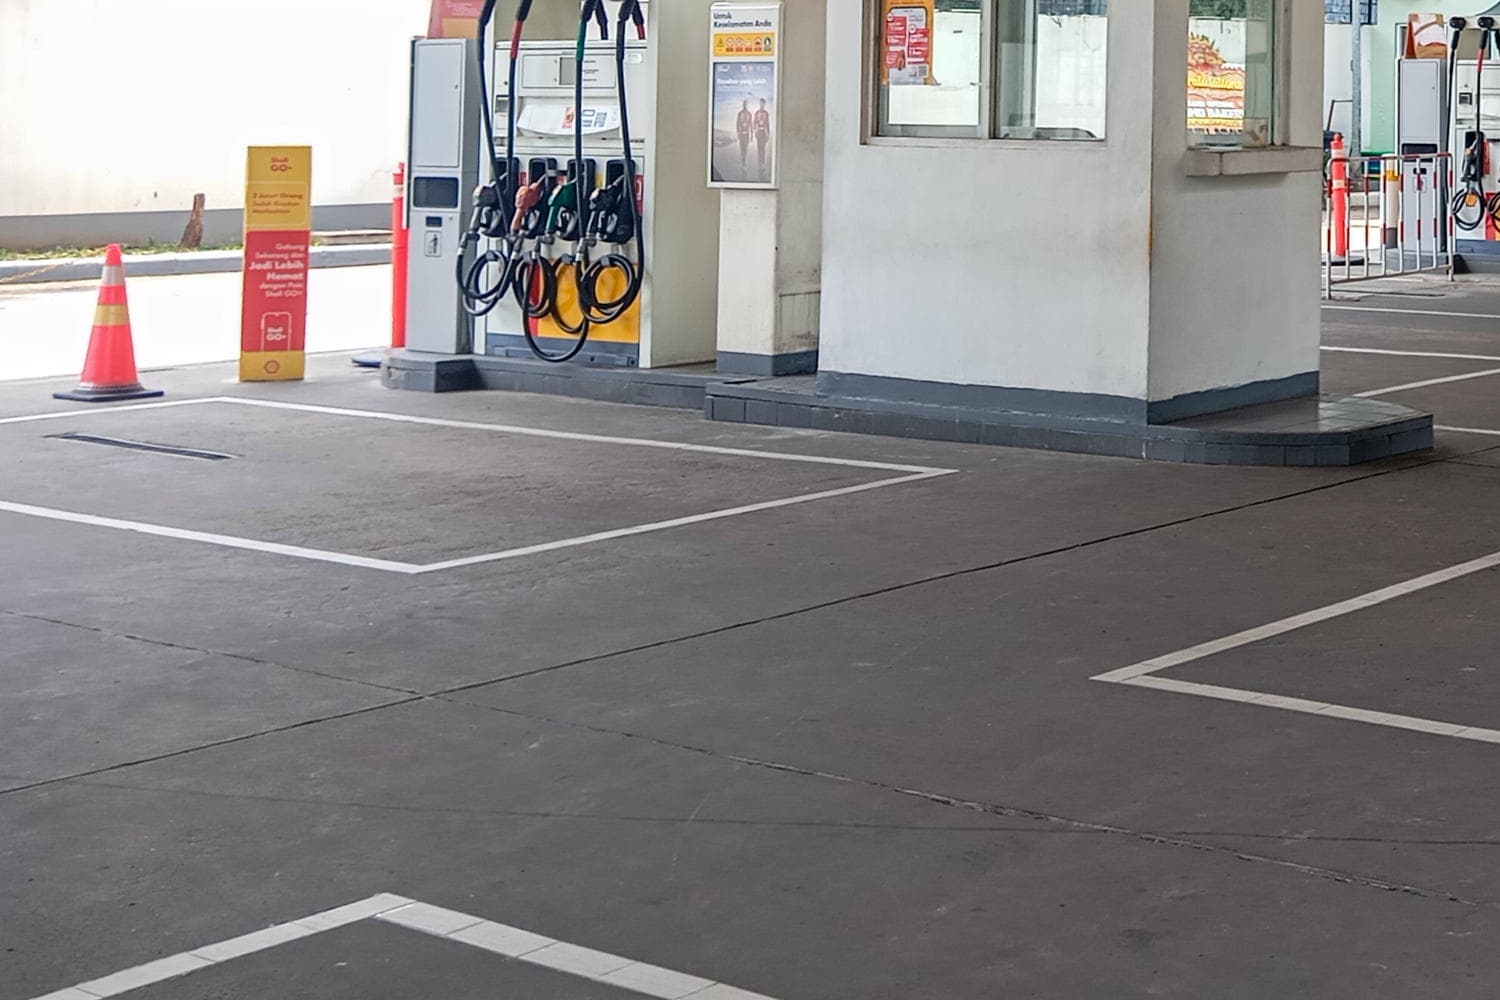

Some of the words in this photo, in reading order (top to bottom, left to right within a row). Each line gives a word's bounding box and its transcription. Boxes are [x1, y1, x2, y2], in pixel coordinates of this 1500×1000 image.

[755, 19, 772, 27] Anda
[250, 261, 273, 270] Jadi
[275, 260, 304, 269] Lebih
[266, 272, 304, 280] Hemat
